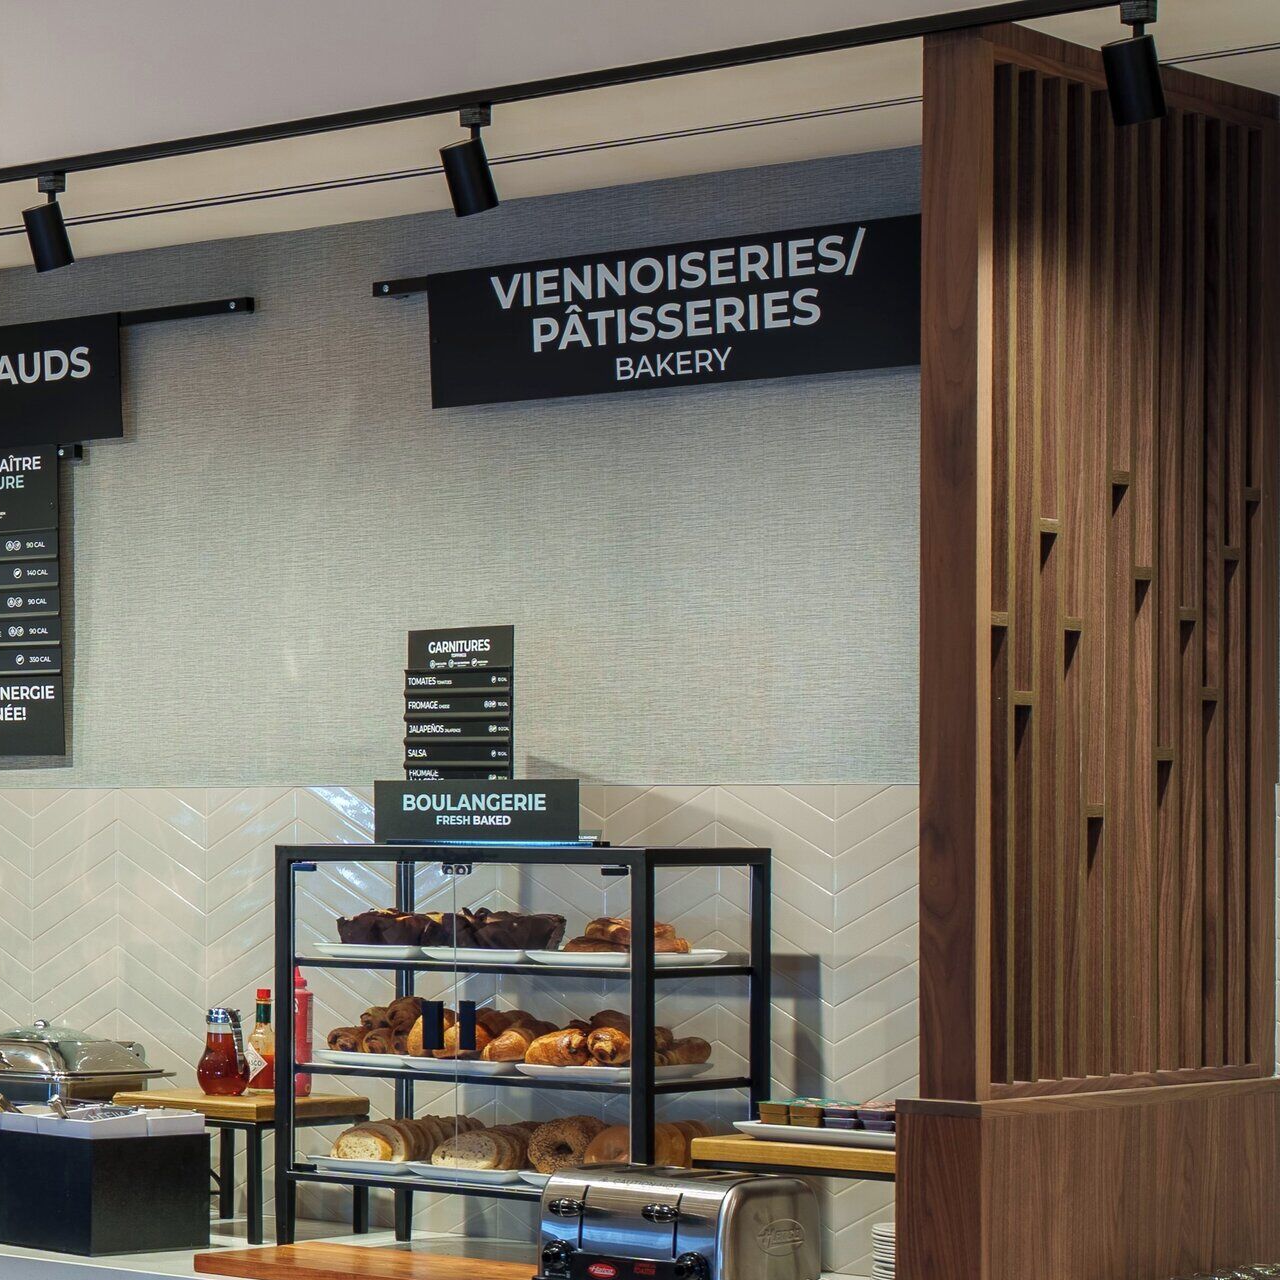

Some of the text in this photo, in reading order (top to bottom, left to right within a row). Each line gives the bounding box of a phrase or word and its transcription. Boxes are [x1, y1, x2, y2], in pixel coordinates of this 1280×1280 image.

[490, 226, 867, 310] VIENNOISERIES/
[532, 287, 822, 353] PÂTISSERIES
[615, 346, 733, 382] BAKERY
[428, 638, 490, 654] GARNITURES
[407, 677, 436, 685] TOMATES
[408, 701, 438, 709] FROMAGE
[408, 723, 444, 733] JALAPEÑOS
[407, 749, 427, 757] SALSA
[402, 793, 546, 811] BOULANGERIE
[436, 815, 511, 825] FRESH BAKED
